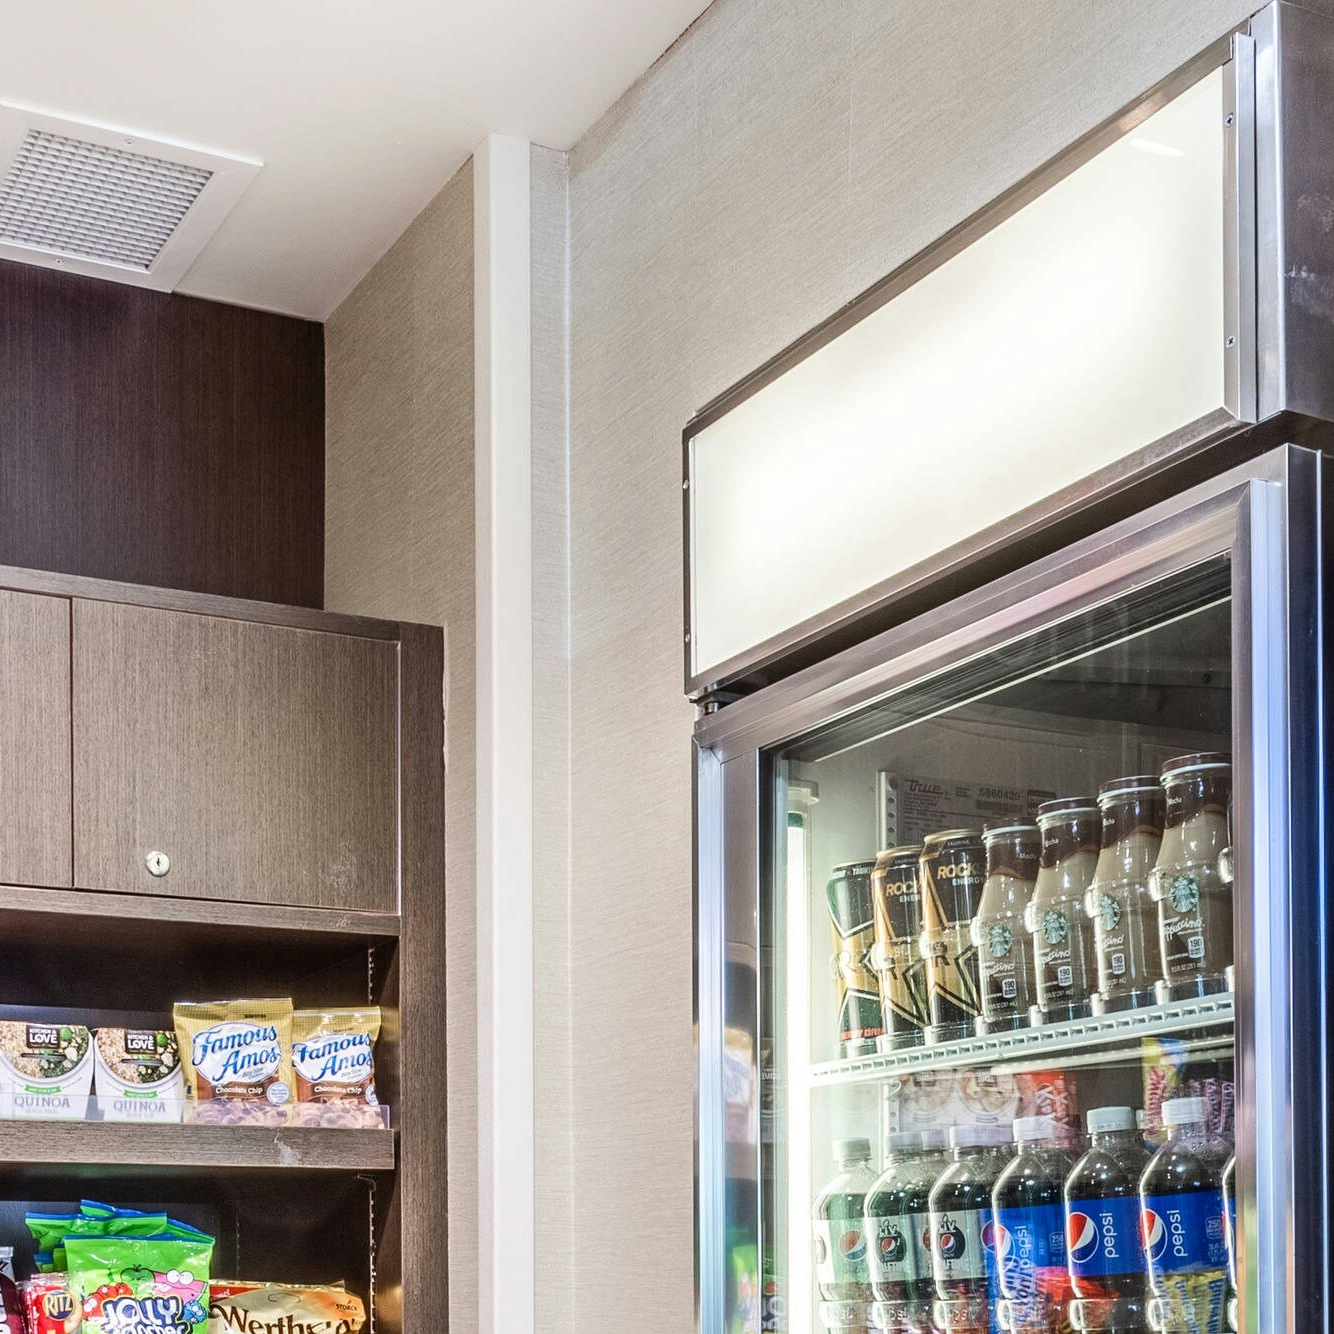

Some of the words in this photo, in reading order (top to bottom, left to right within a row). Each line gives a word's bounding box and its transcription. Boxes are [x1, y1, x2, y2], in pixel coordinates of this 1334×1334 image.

[193, 1026, 277, 1066] Famous
[213, 1046, 281, 1081] Amos
[1100, 1211, 1118, 1258] pepsi
[104, 1300, 178, 1328] JOLLY
